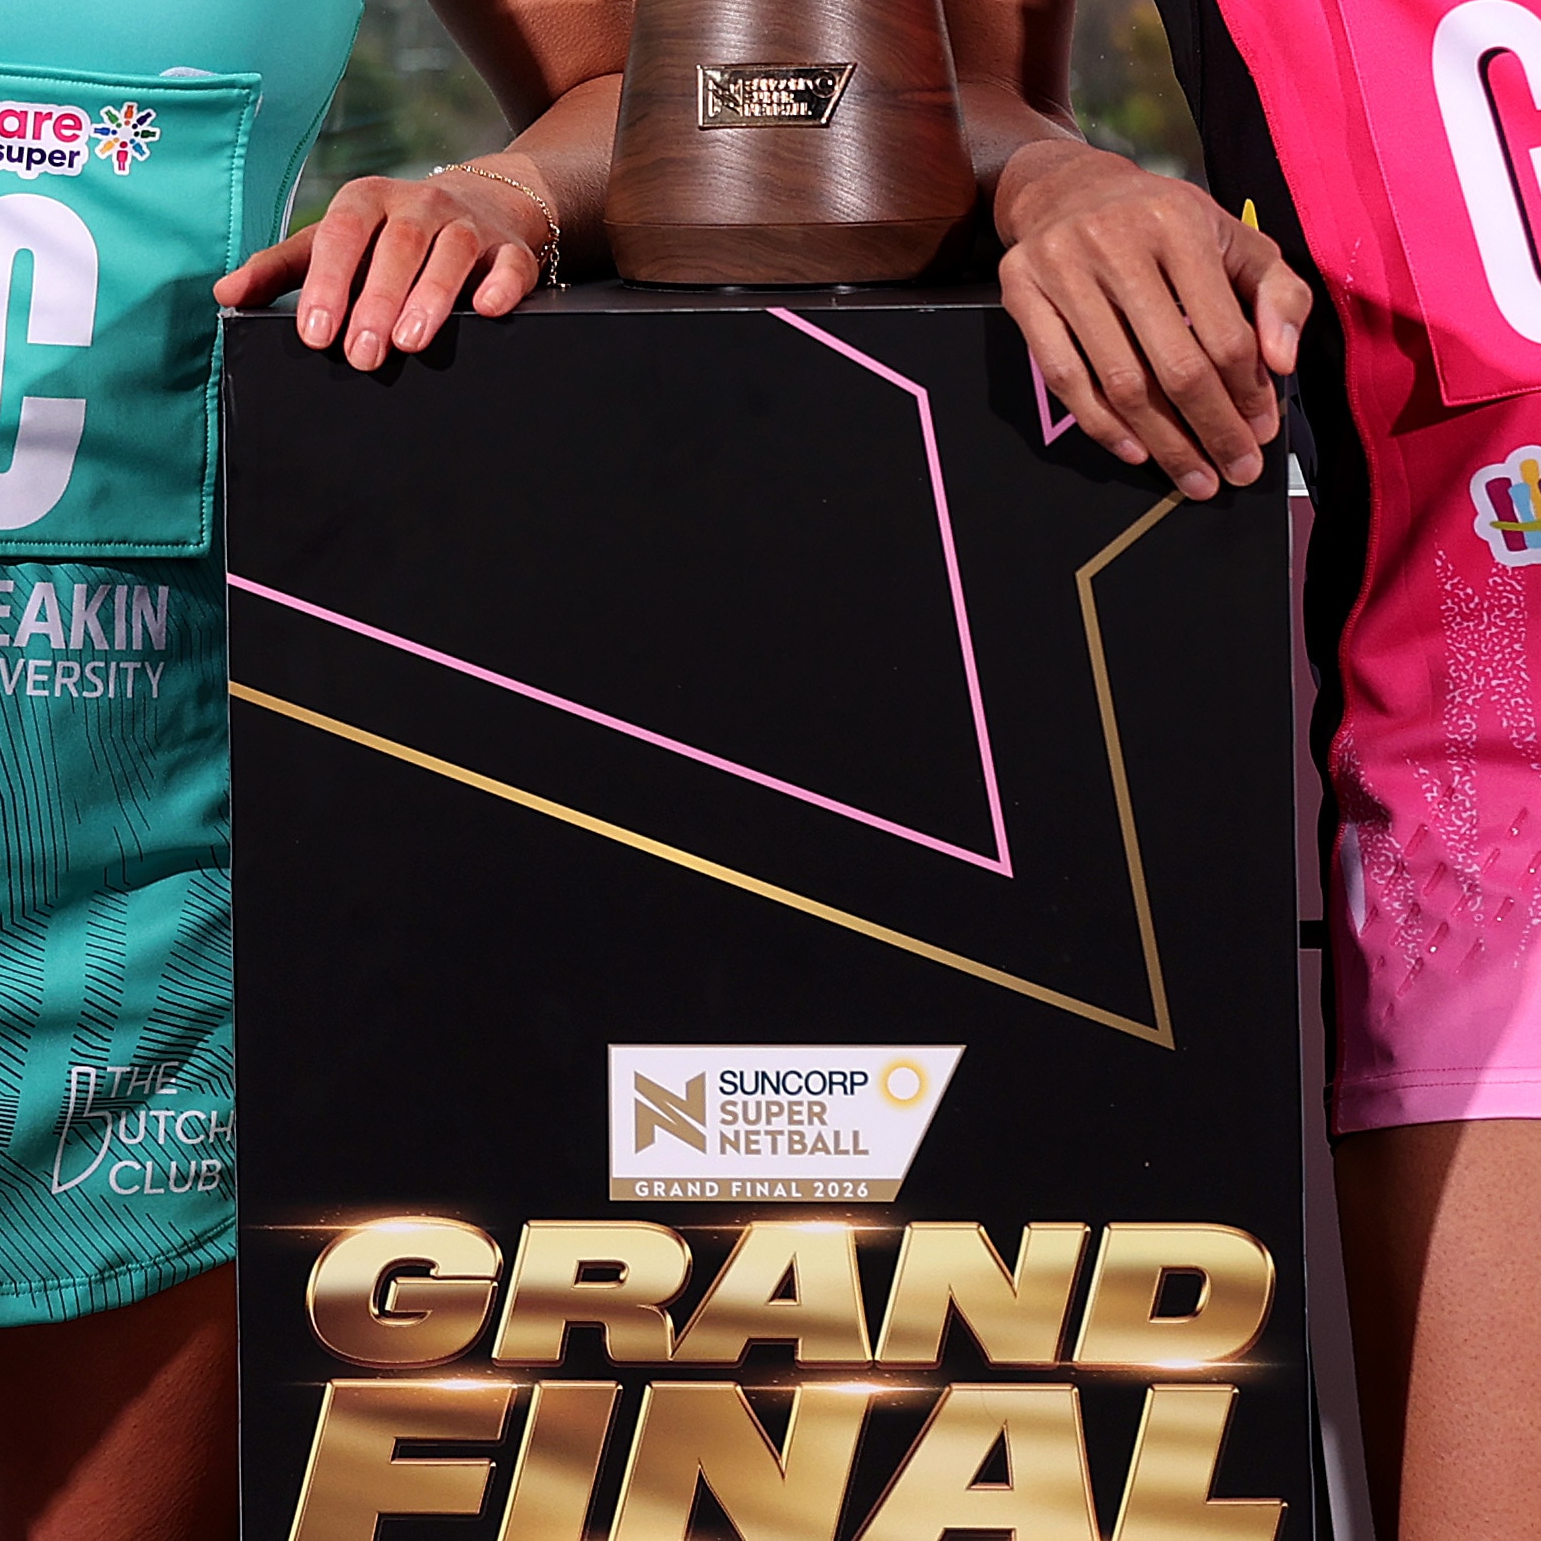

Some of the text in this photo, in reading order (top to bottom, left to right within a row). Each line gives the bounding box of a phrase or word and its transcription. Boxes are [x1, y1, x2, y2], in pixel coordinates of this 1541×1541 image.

[107, 1061, 179, 1098] THE
[718, 1069, 869, 1096] SUNCORP
[720, 1100, 828, 1126] SUPER
[720, 1130, 870, 1156] NETBALL
[109, 1159, 222, 1195] CLUB
[634, 1181, 869, 1198] GRAND FINAL 2026
[305, 1214, 1276, 1369] GRAND
[288, 1379, 1289, 1541] FINAL
